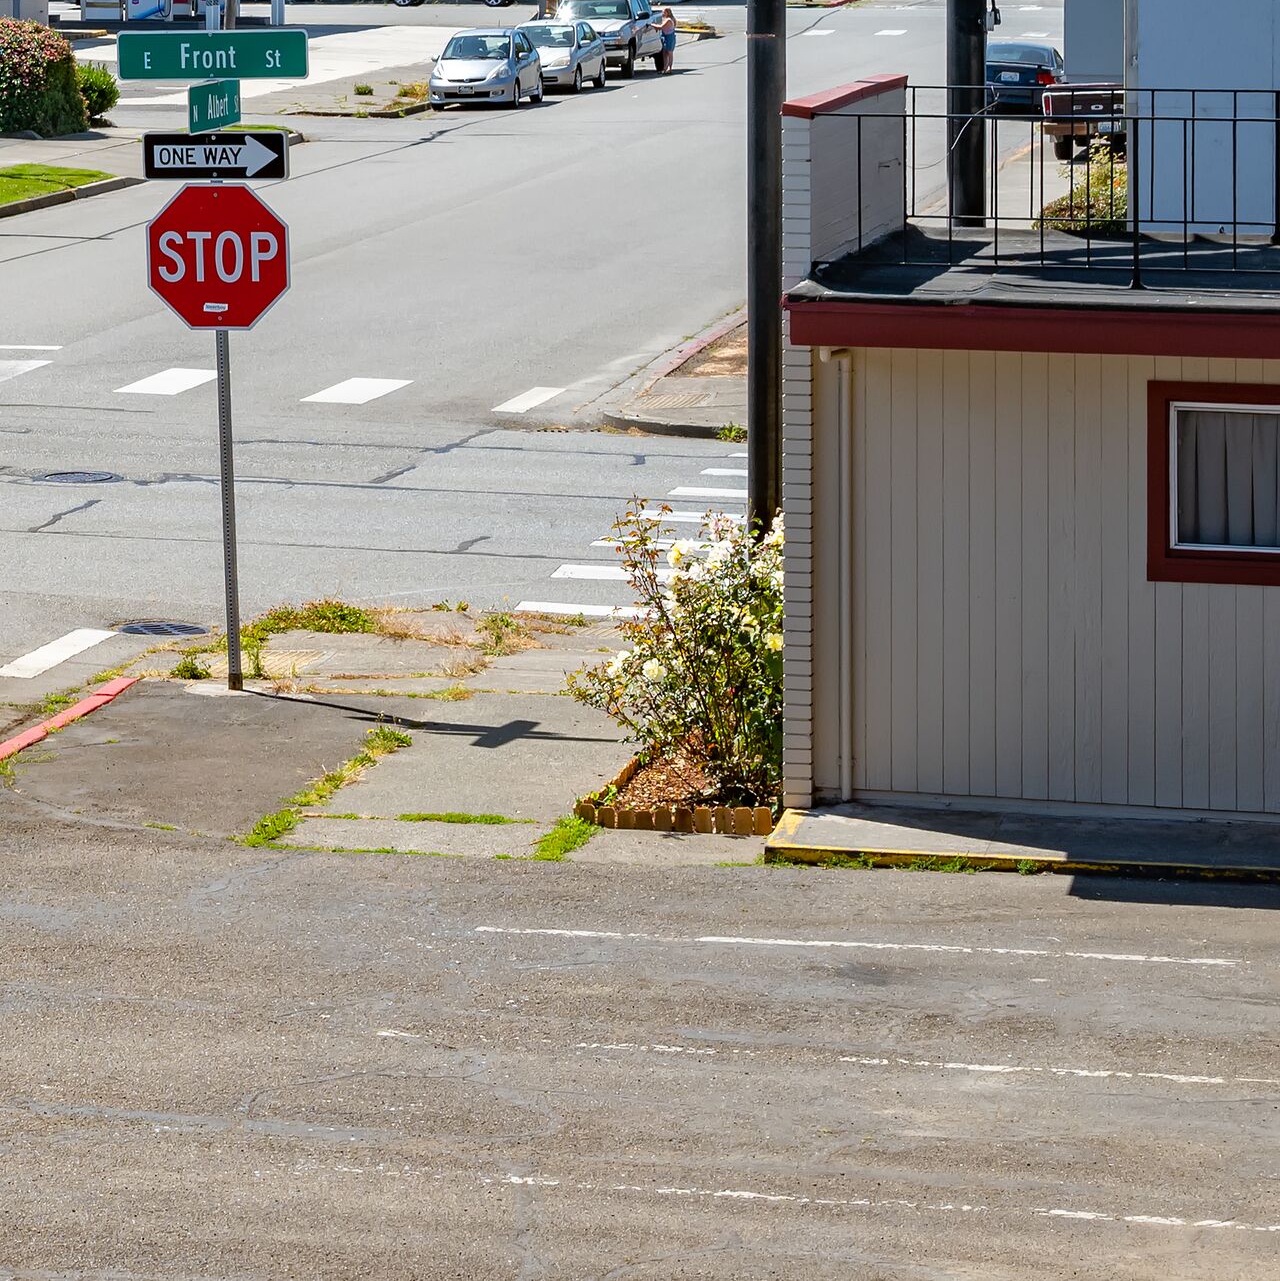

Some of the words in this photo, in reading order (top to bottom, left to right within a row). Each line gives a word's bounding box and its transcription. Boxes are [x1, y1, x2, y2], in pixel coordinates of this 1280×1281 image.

[144, 51, 151, 69] E
[180, 43, 236, 69] Front
[265, 50, 281, 68] St
[193, 105, 198, 123] N
[207, 92, 229, 120] Albert
[159, 147, 196, 166] ONE
[204, 146, 243, 166] WAY
[158, 230, 279, 284] STOP
